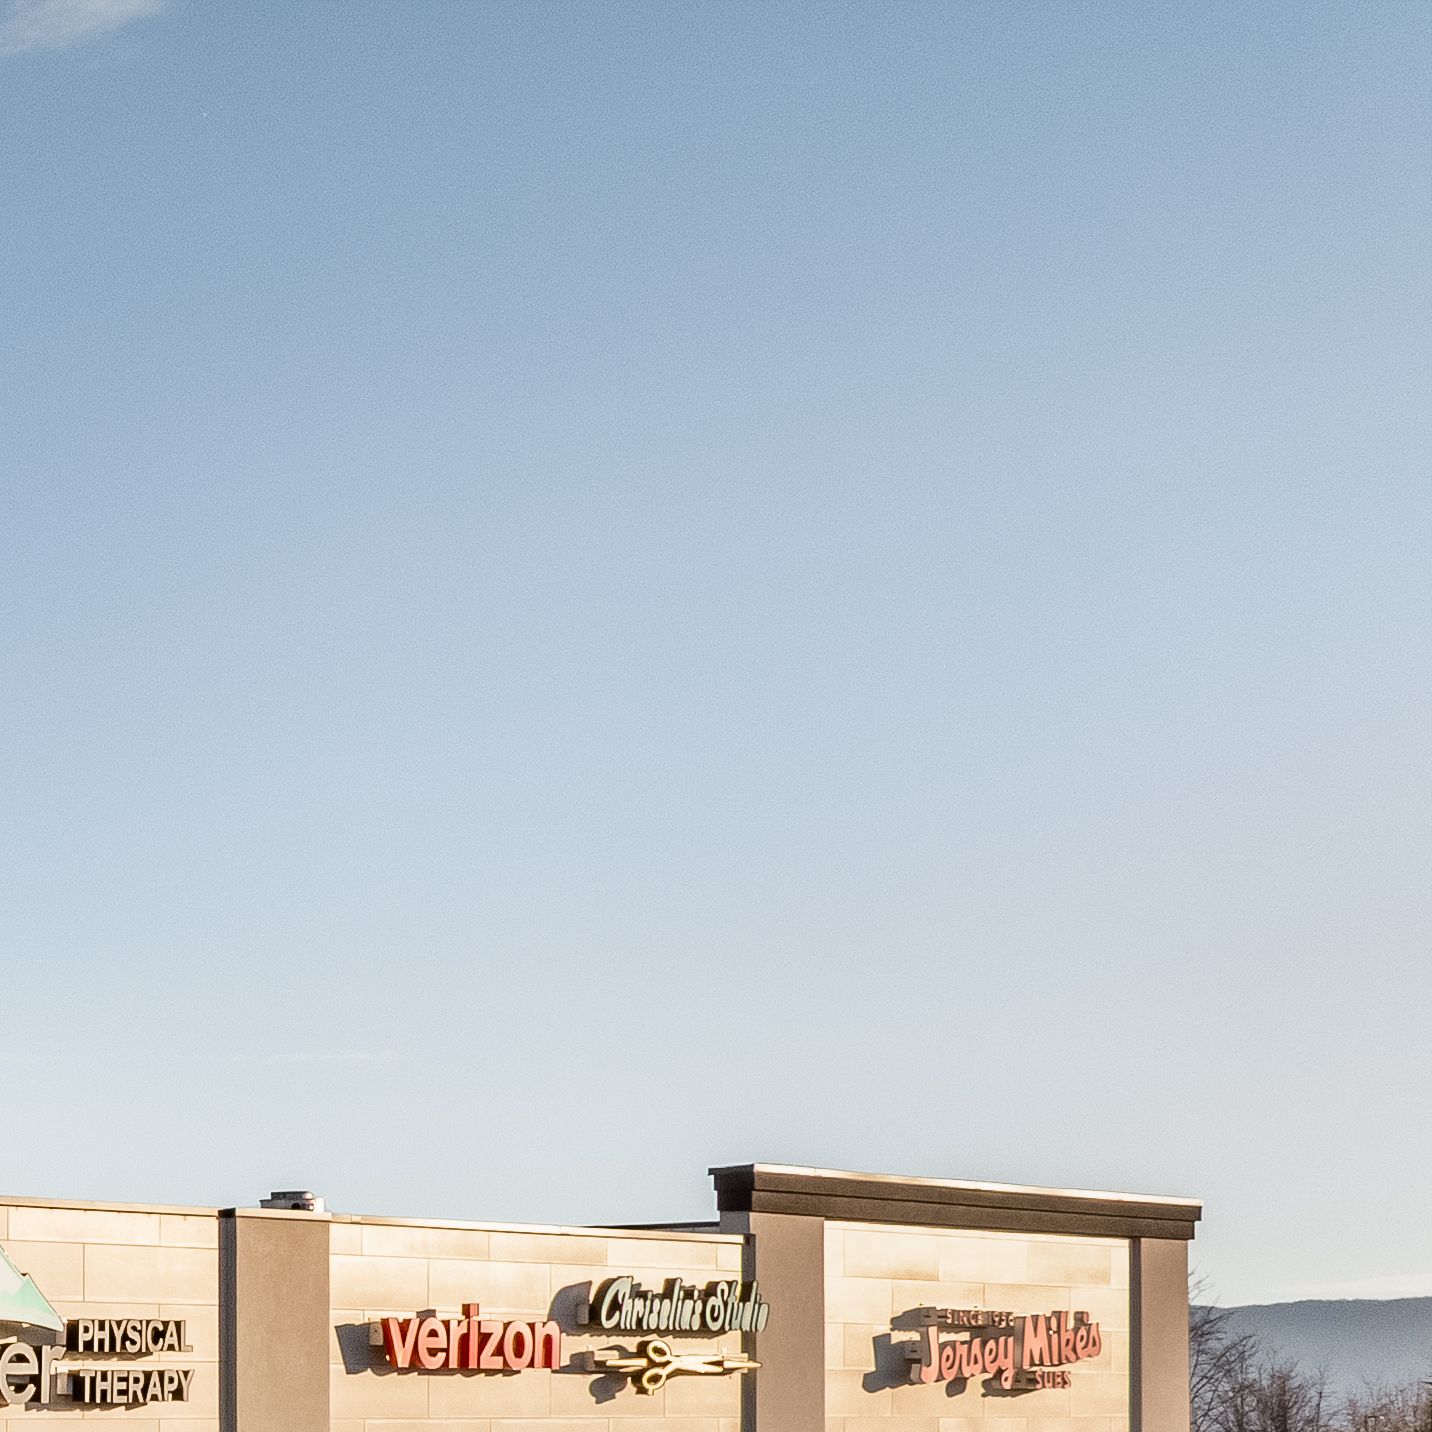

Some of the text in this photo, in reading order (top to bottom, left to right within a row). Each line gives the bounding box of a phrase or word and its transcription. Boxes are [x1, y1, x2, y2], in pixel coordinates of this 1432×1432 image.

[705, 1280, 769, 1333] Studio
[77, 1319, 193, 1353] PHYSICAL
[388, 1303, 560, 1369] verizon
[920, 1310, 1102, 1390] Jersey Mike's
[79, 1368, 196, 1403] THERAPY
[1035, 1370, 1072, 1389] SUBS
